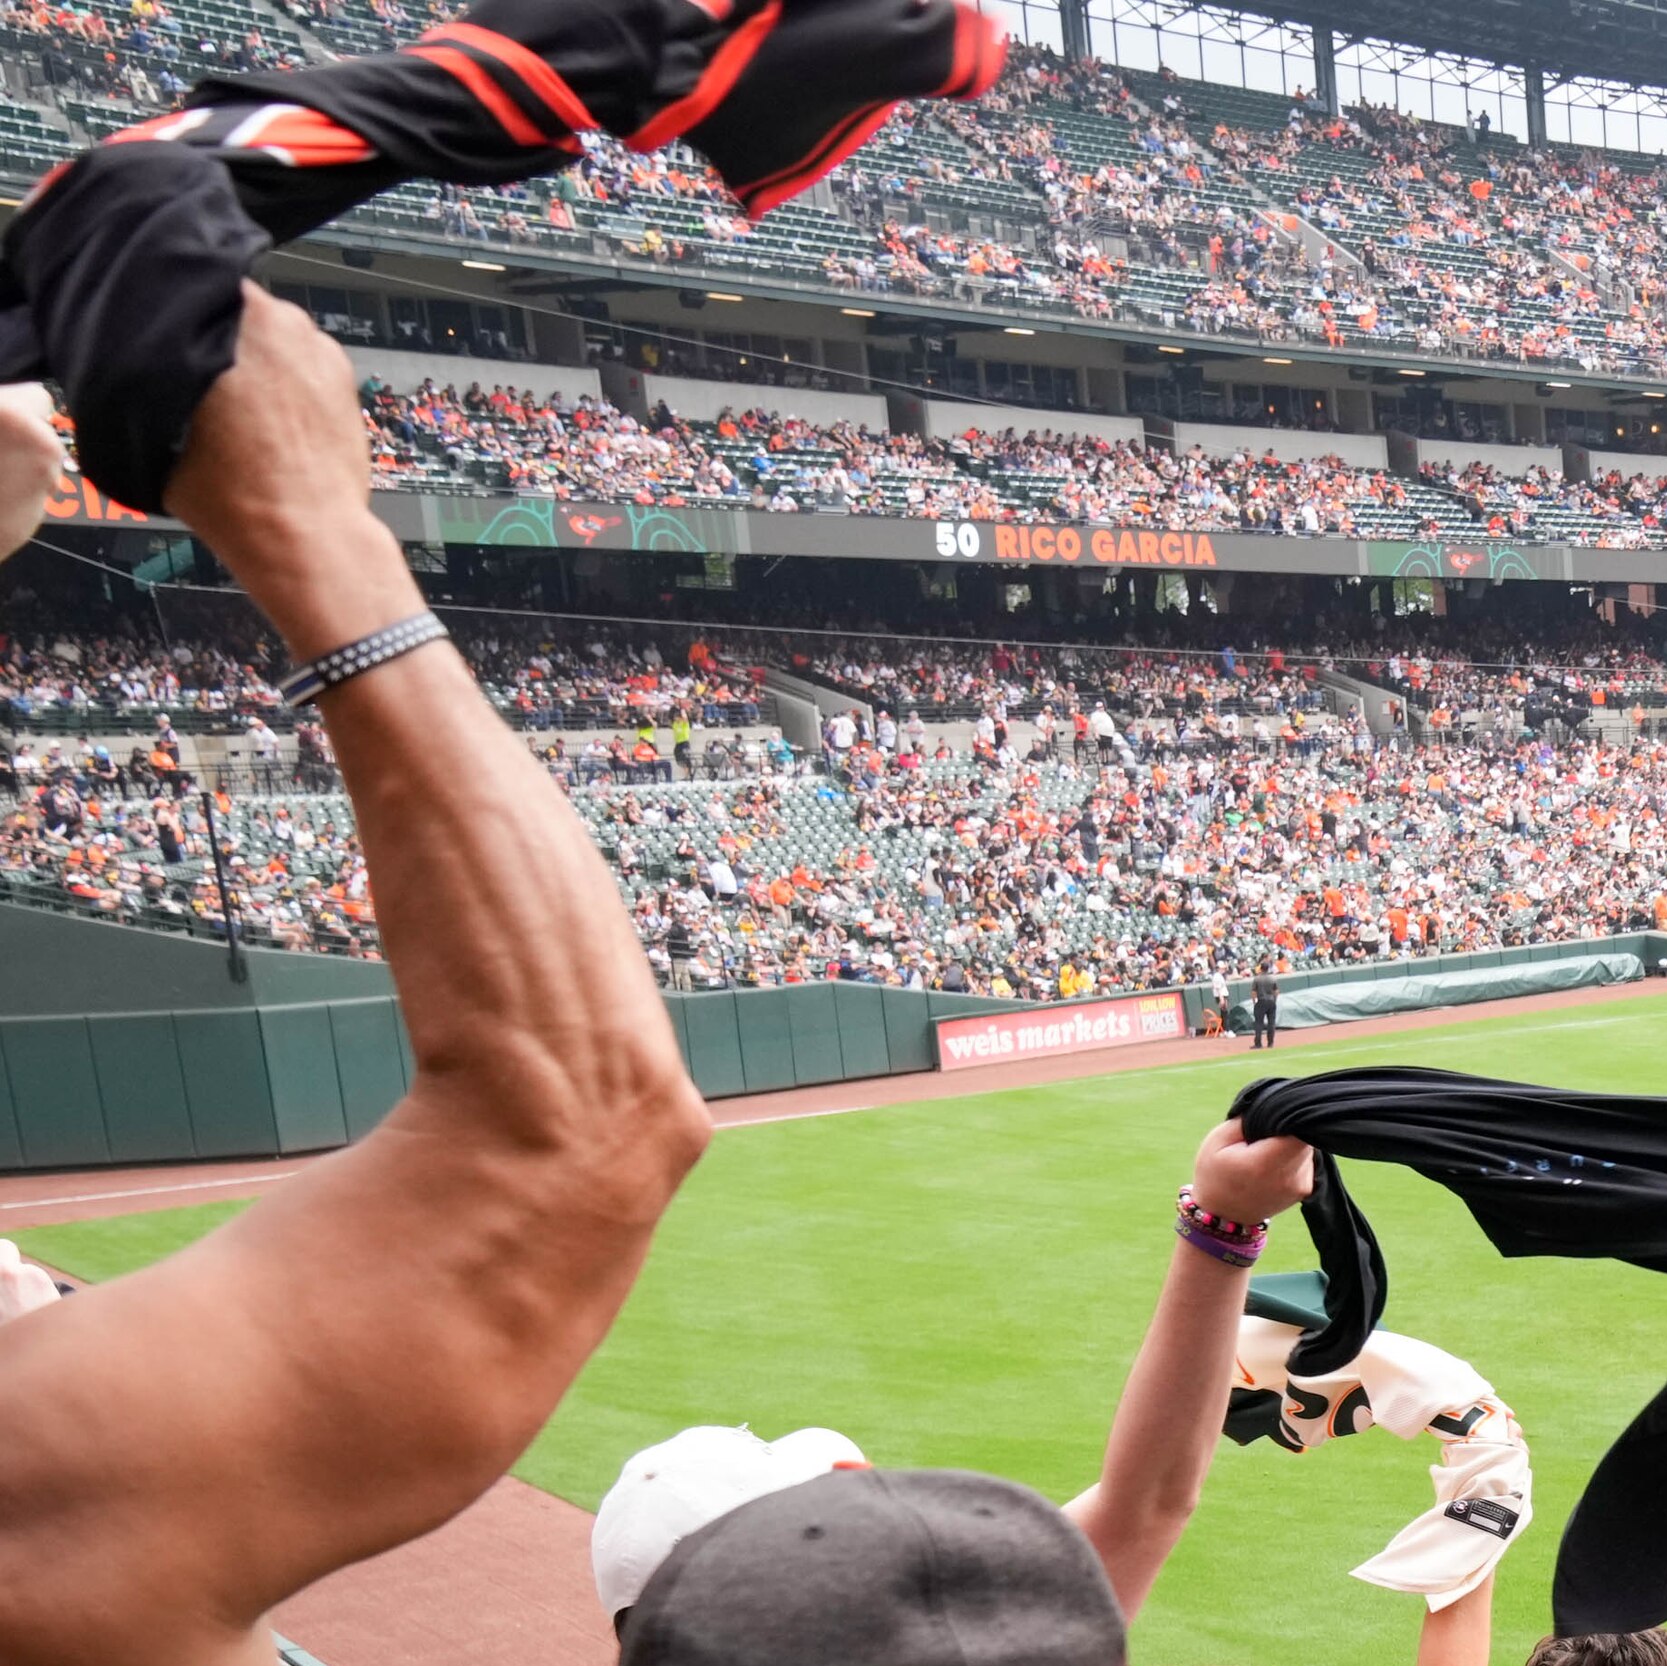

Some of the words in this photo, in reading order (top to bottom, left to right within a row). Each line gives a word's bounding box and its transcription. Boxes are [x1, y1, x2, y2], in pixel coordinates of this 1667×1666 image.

[936, 522, 980, 557] 50
[995, 525, 1081, 561] RICO
[1091, 529, 1216, 566] GARCIA
[945, 1024, 1013, 1060] weis
[1017, 1011, 1131, 1049] markets
